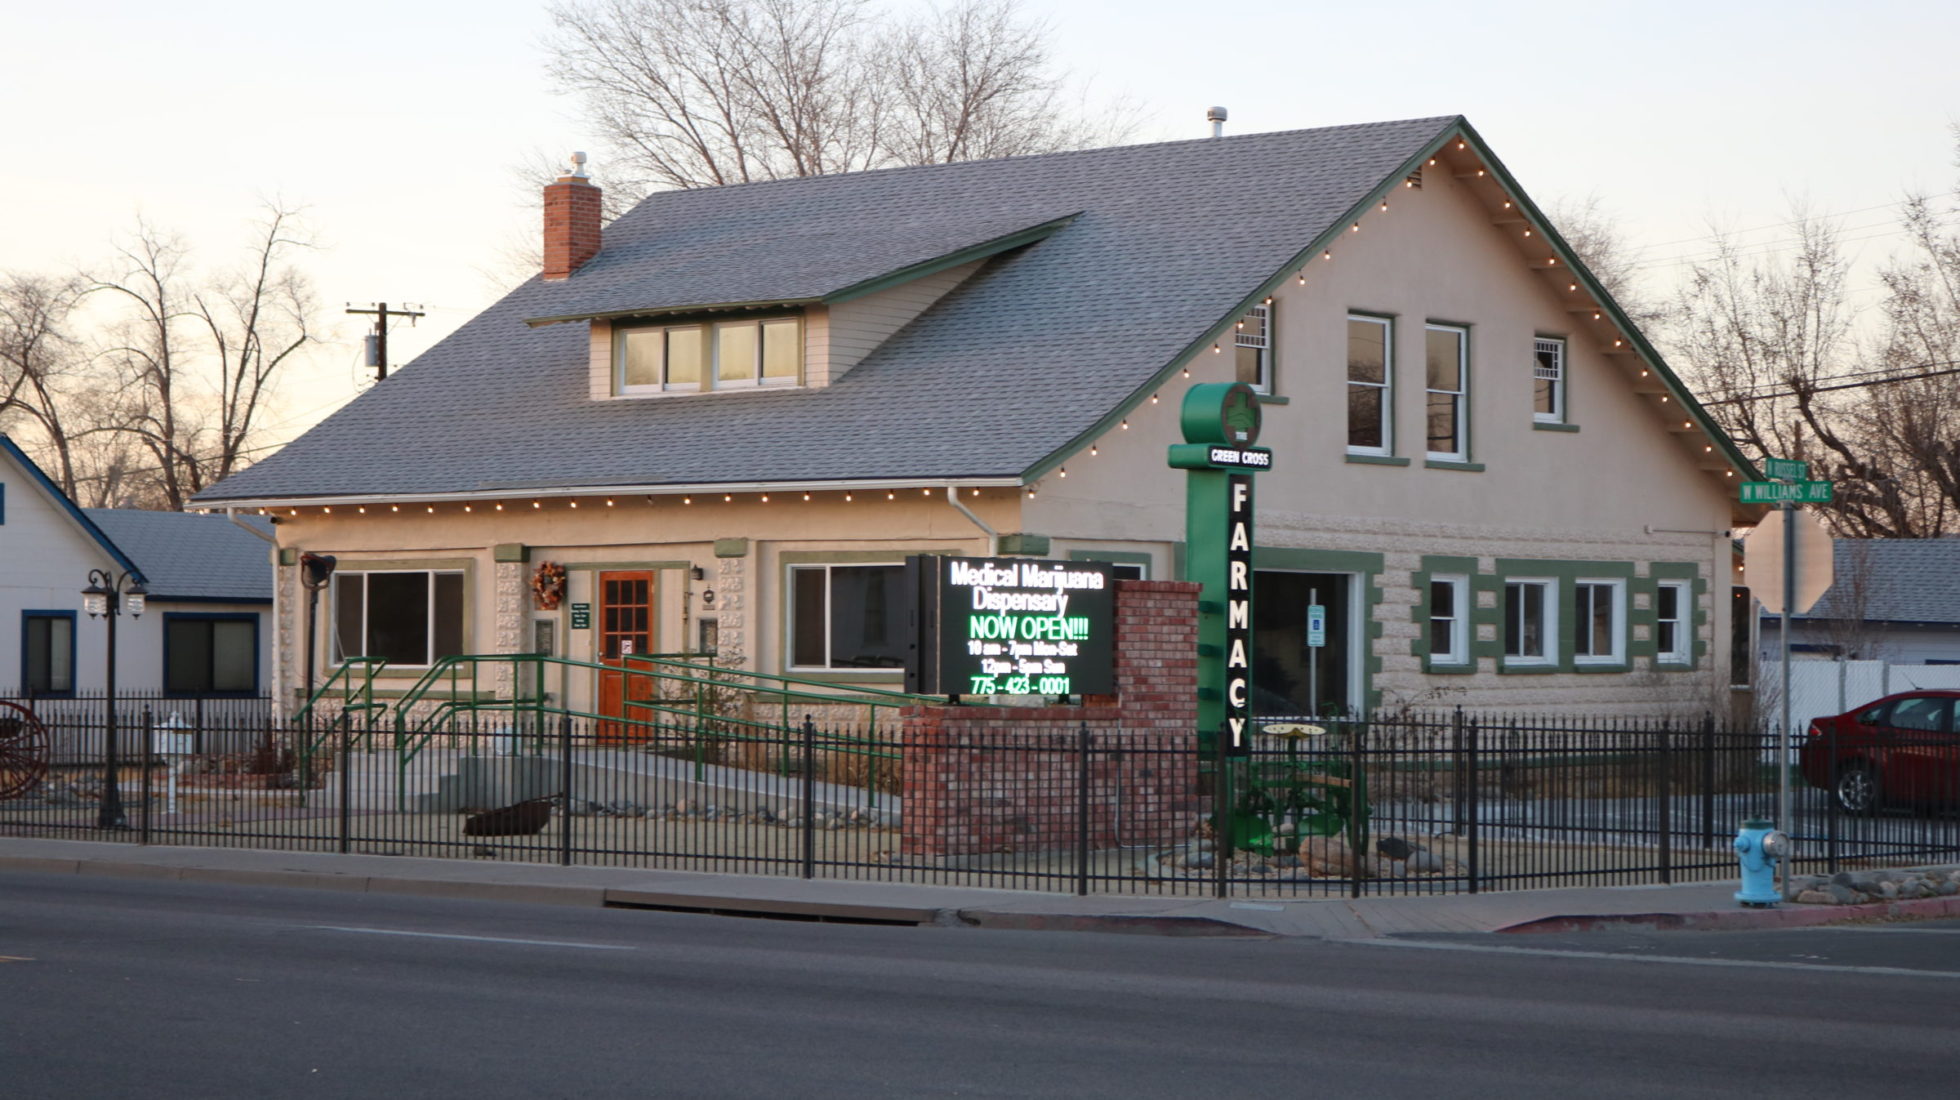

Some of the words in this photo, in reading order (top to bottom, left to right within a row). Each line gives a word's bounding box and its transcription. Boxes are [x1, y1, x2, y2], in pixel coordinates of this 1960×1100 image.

[1211, 449, 1240, 463] GREEN
[1242, 451, 1269, 465] CROSS
[1743, 485, 1752, 500] W
[1755, 484, 1803, 500] WILLIAMS
[1809, 484, 1828, 499] AVE
[951, 561, 1019, 587] Medical
[1022, 563, 1104, 594] Marijuana
[972, 586, 1069, 618] Dispensary
[1229, 483, 1249, 747] FARMACY
[970, 616, 1018, 639] NOW
[1020, 617, 1089, 640] OPEN!!!
[981, 658, 1011, 678] 12pm
[1019, 658, 1042, 678] 5pm
[1043, 658, 1065, 674] Sun
[970, 677, 995, 694] 775
[1005, 677, 1030, 694] 423
[1040, 677, 1070, 694] 0001
